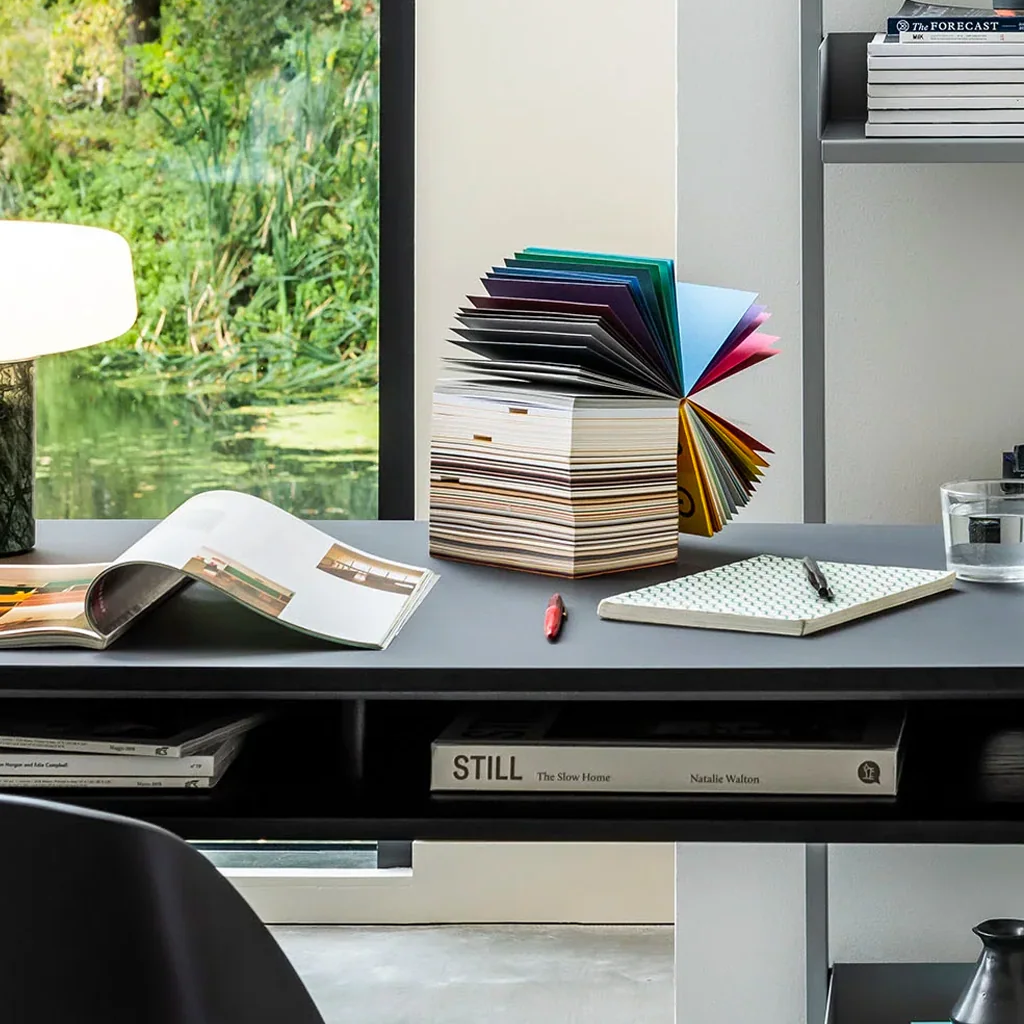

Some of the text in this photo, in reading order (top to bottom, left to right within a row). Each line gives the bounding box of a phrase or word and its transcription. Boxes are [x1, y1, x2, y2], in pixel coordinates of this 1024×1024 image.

[911, 21, 999, 31] The FORECAST
[453, 754, 523, 780] STILL
[536, 771, 611, 782] The Slow Home
[690, 773, 760, 785] Natalie Walton
